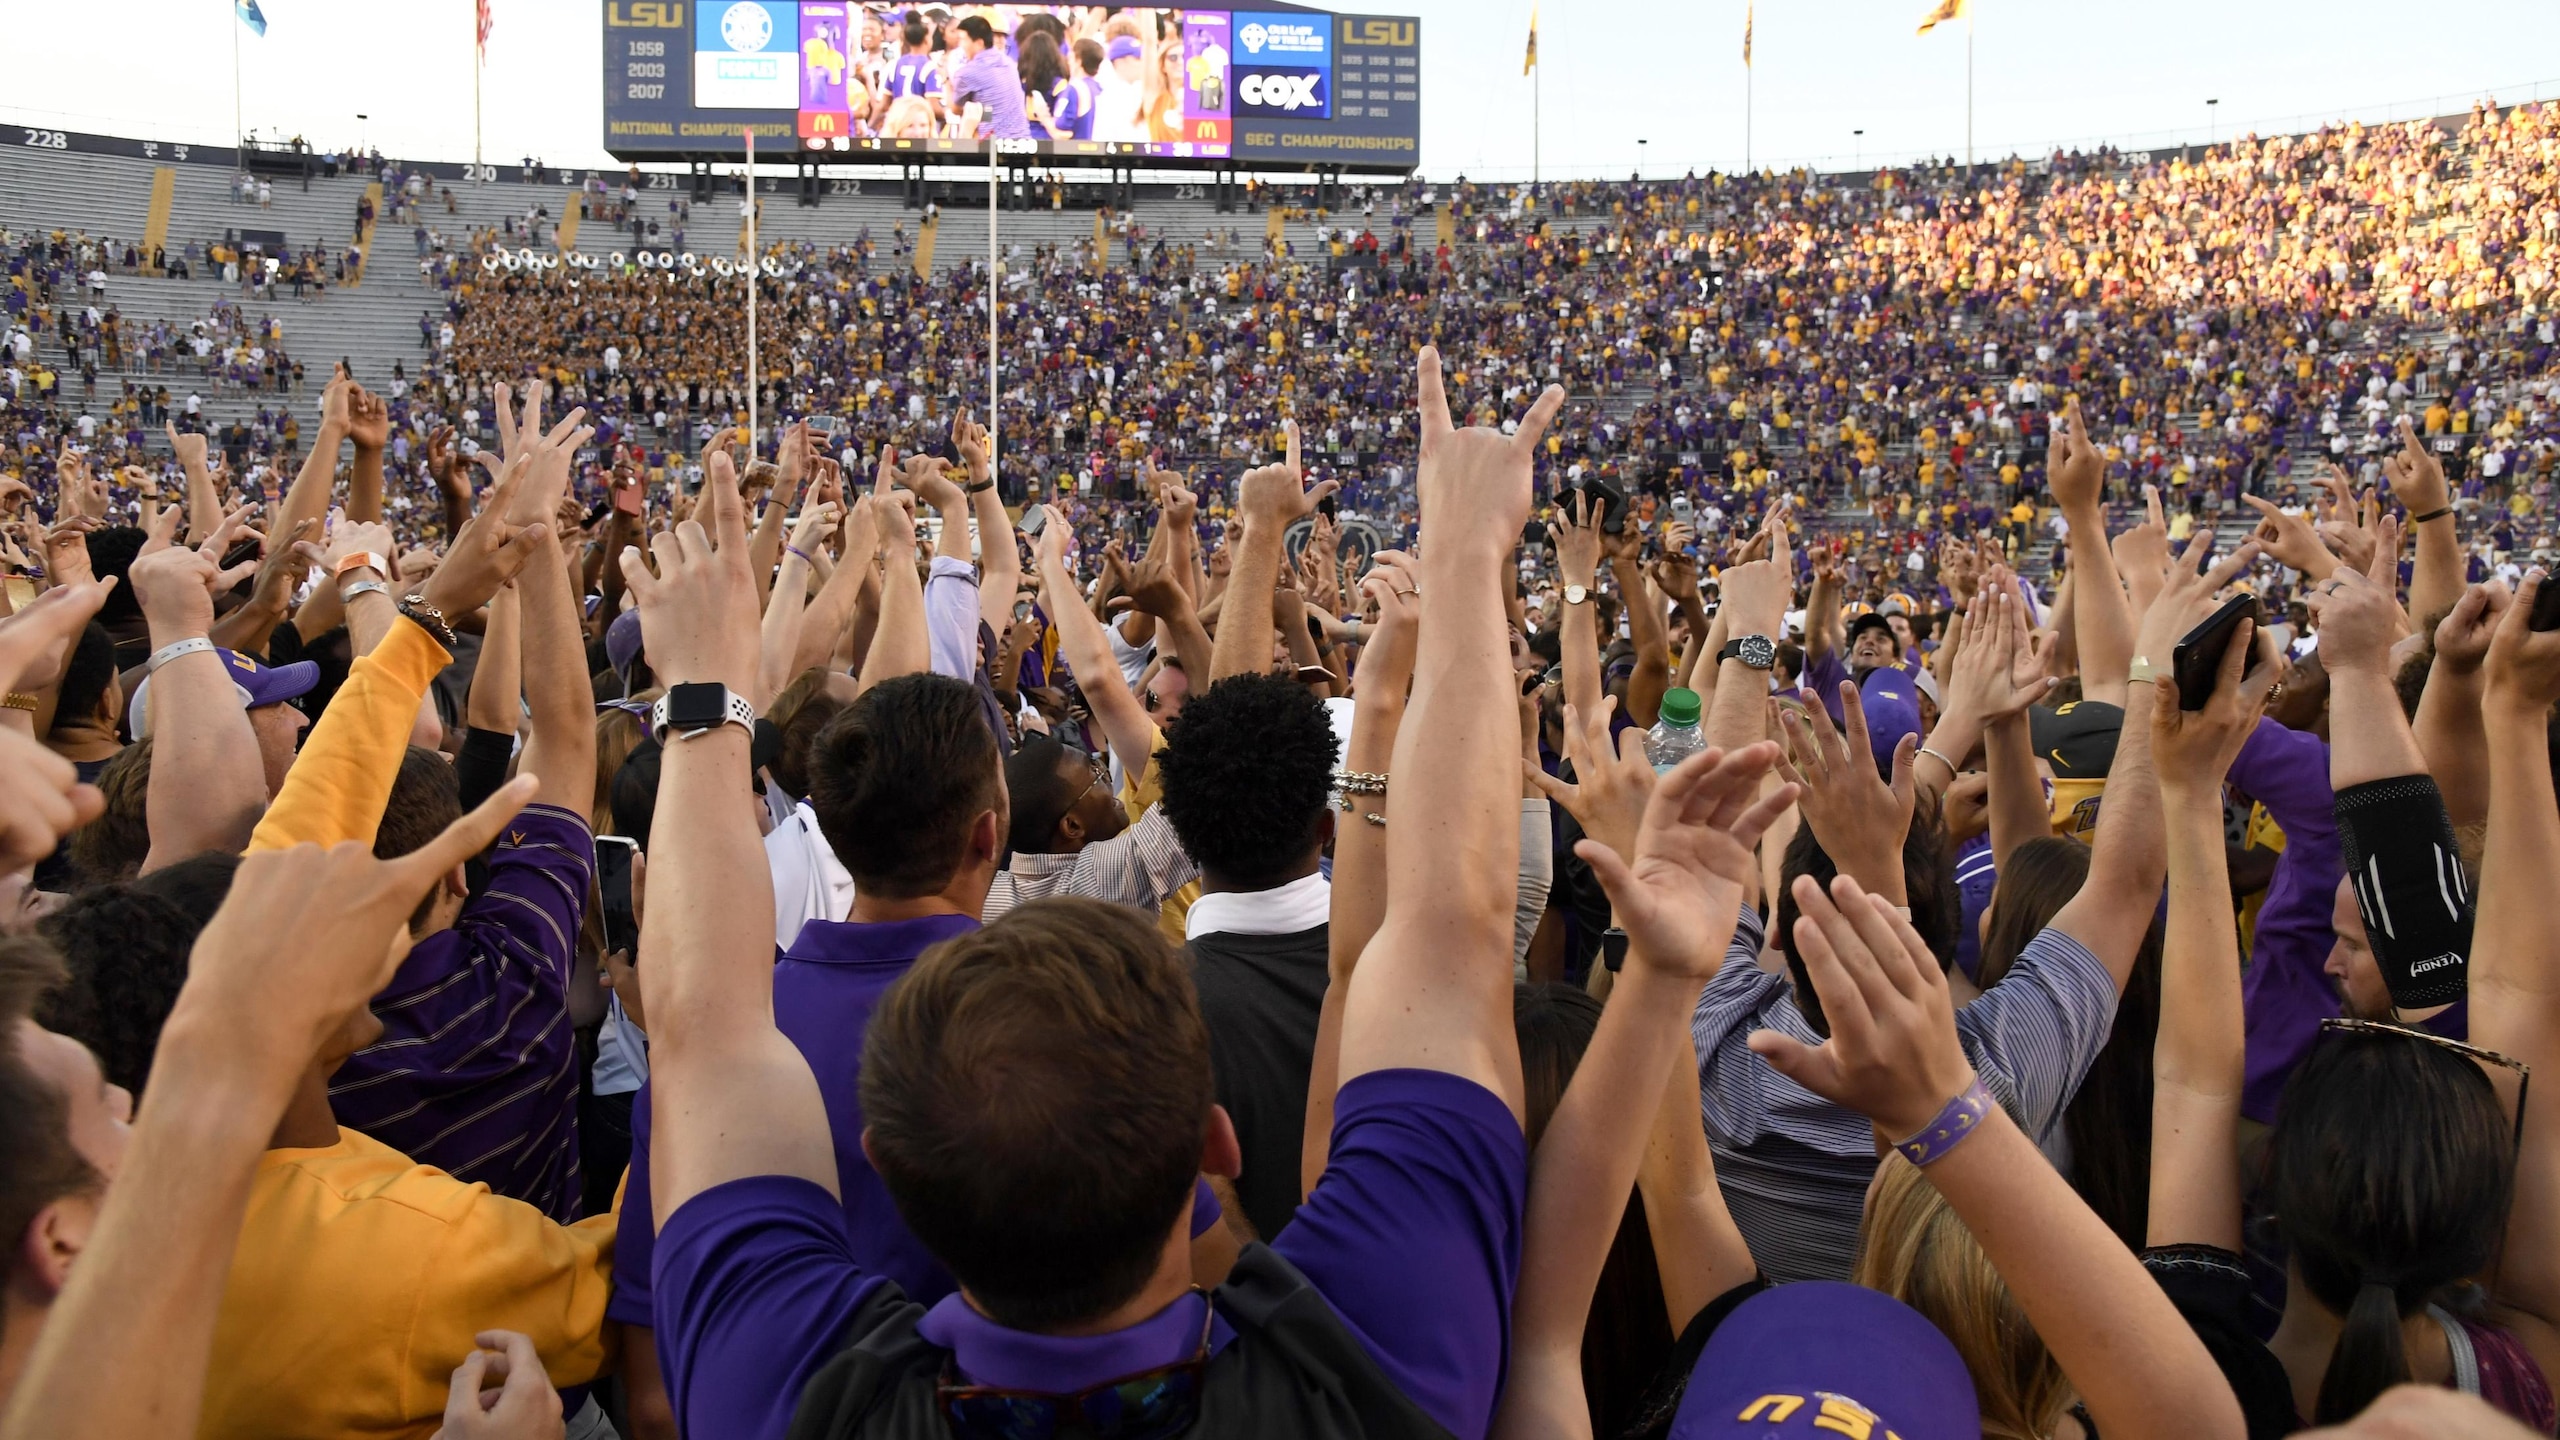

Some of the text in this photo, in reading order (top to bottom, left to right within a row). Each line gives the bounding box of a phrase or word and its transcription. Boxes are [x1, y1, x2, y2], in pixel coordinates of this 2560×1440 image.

[608, 1, 684, 28] LSU
[1343, 20, 1415, 46] LSU
[629, 41, 665, 56] 1958
[628, 63, 665, 78] 2003
[628, 84, 665, 99] 2007
[1239, 74, 1321, 111] COX
[610, 121, 674, 136] NATIONAL
[25, 129, 68, 149] 228
[1245, 133, 1415, 151] SEC CHAMPIONSHIPS
[648, 174, 678, 189] 231
[831, 181, 861, 195] 232
[1175, 185, 1205, 199] 234
[2410, 951, 2463, 977] VENOM
[1737, 1394, 1902, 1440] SU
